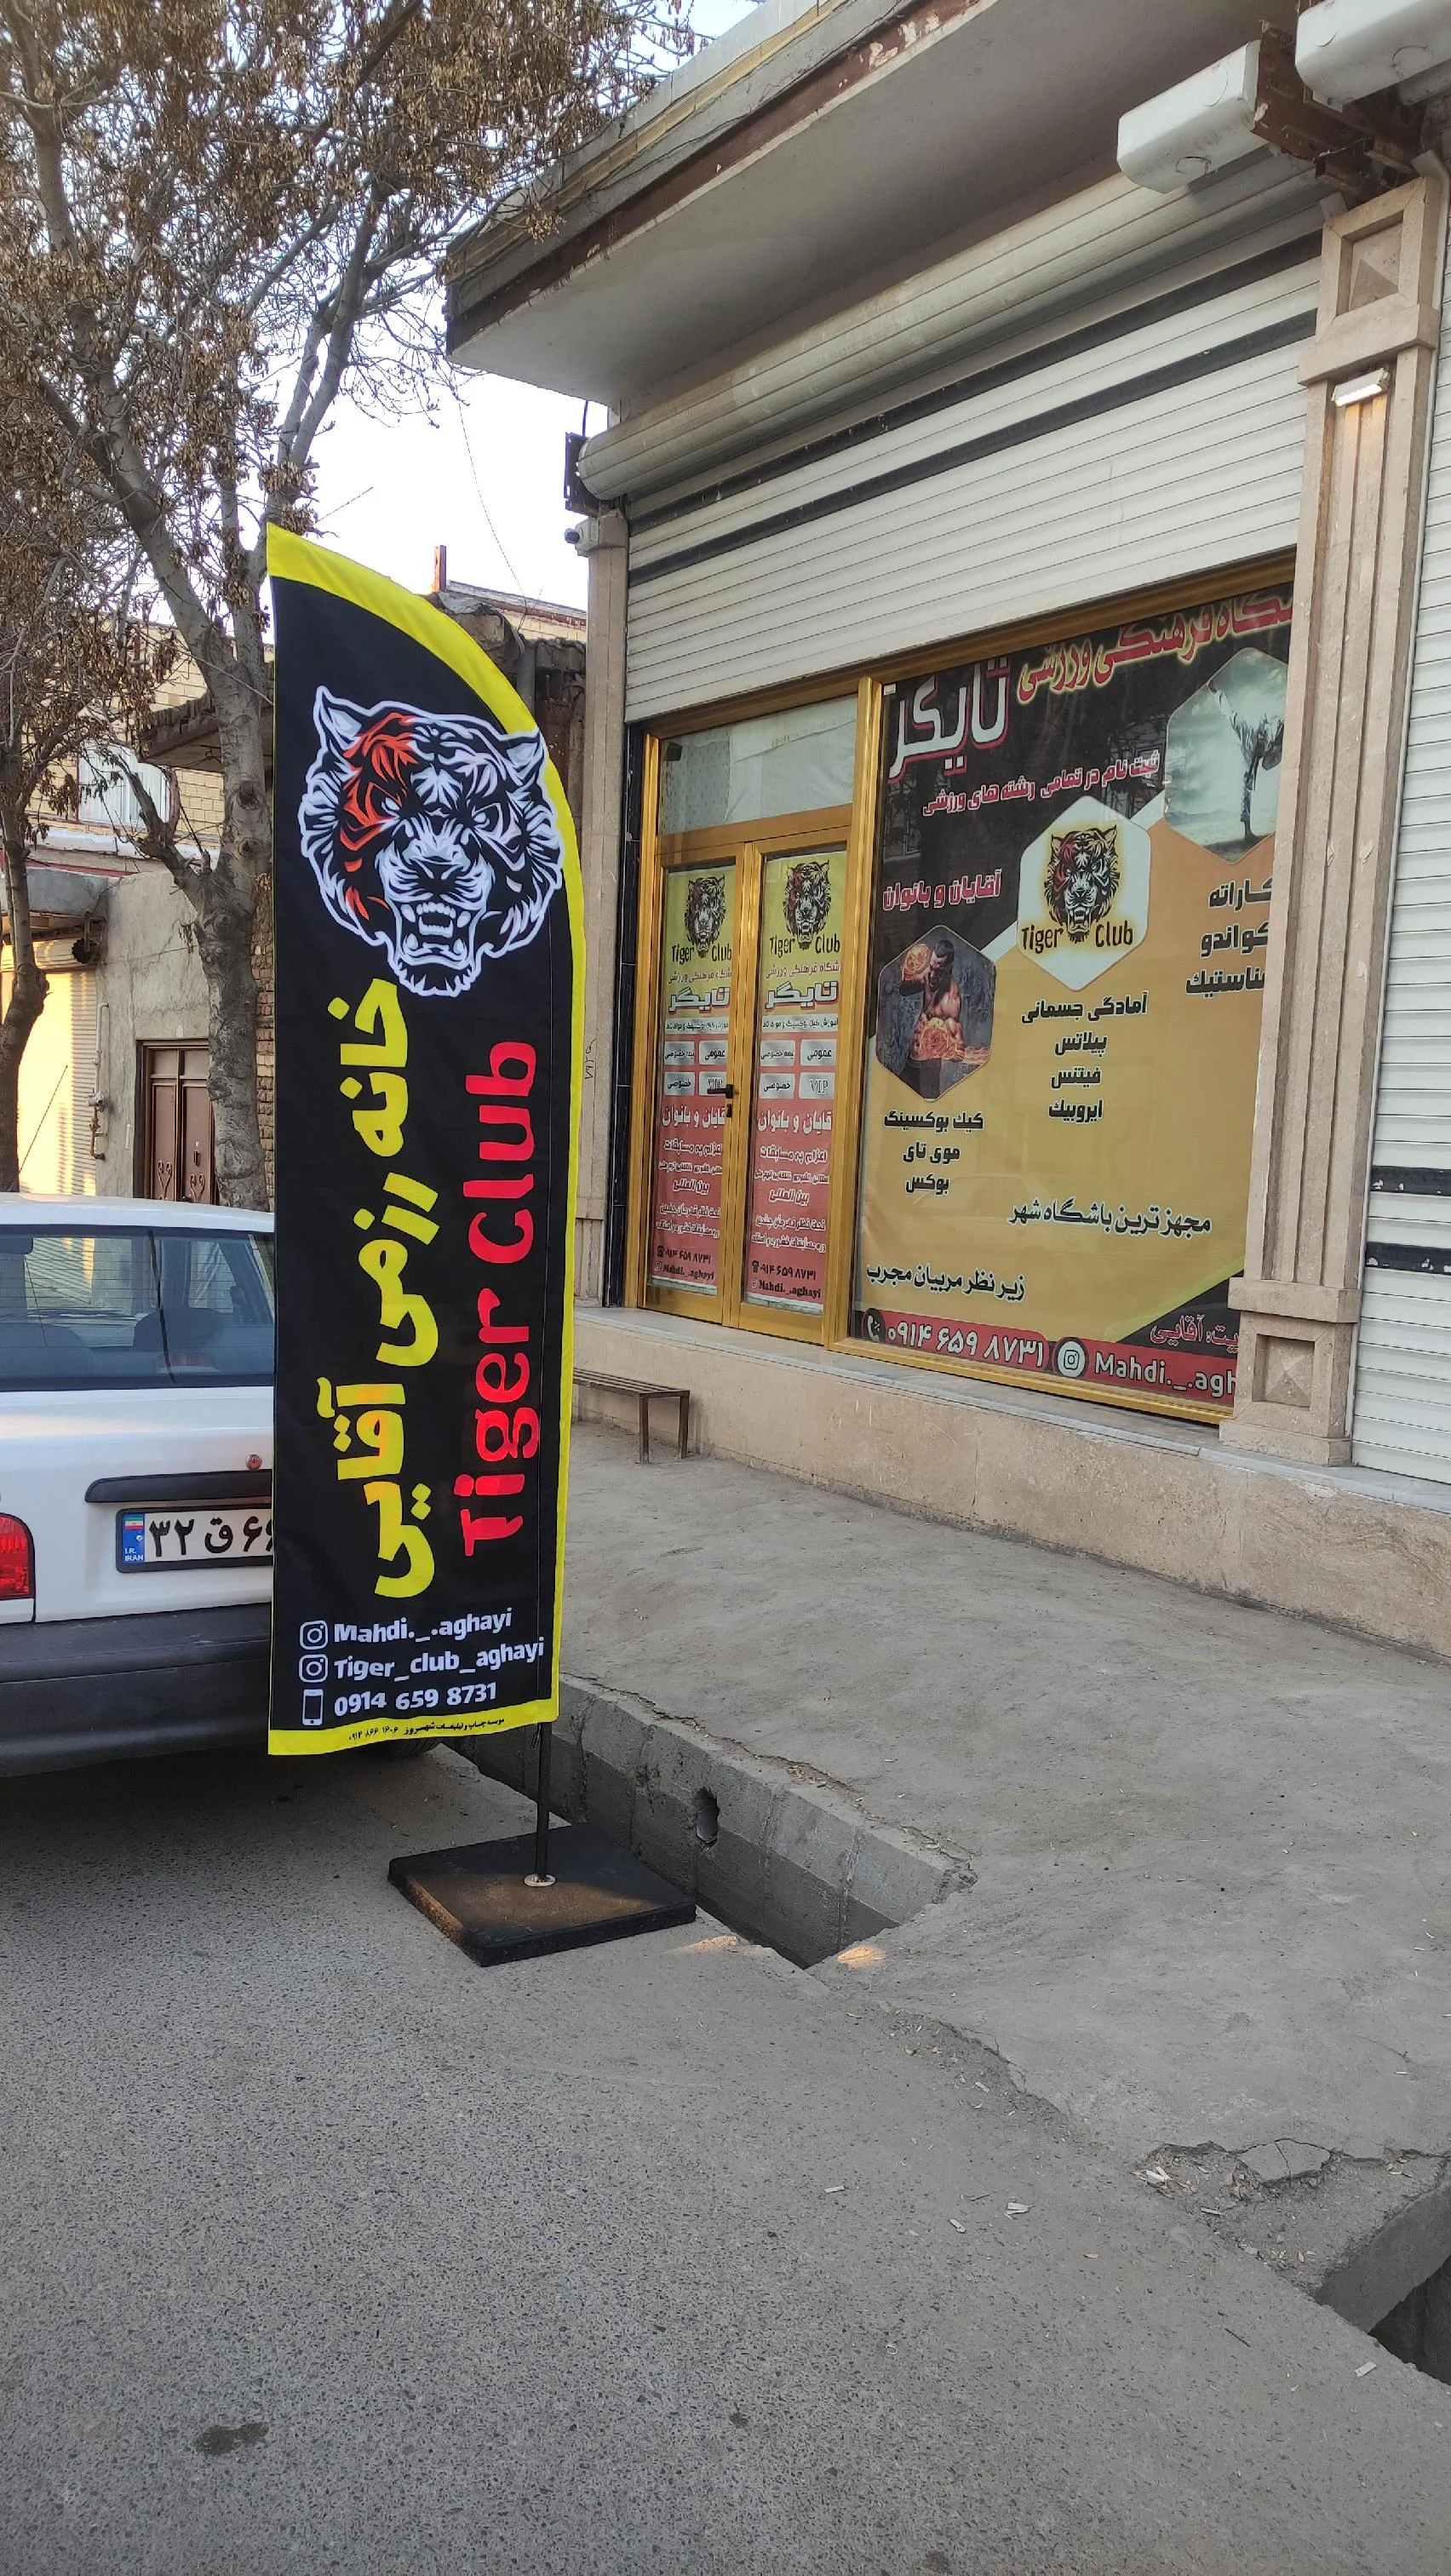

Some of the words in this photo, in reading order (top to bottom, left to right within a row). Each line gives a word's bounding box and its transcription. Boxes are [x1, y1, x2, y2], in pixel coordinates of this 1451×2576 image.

[1041, 768, 1083, 798] تمامی
[1085, 769, 1099, 790] در
[1102, 760, 1127, 787] نام
[967, 784, 1000, 810] های
[1001, 776, 1035, 800] رشته
[923, 789, 966, 816] ورزشی
[882, 881, 931, 912] بانوان
[934, 884, 946, 909] و
[949, 868, 1002, 905] آقایان
[770, 934, 795, 958] Tiger
[815, 933, 840, 954] Club
[1022, 925, 1064, 954] Tiger
[1095, 921, 1133, 948] Club
[672, 944, 694, 964] Tiger
[712, 944, 731, 961] Club
[668, 986, 731, 1014] تایگر
[765, 980, 838, 1012] تایگر
[1087, 990, 1149, 1022] آمادگی
[1021, 999, 1084, 1024] جسمانی
[807, 1049, 832, 1061] عمومی
[1054, 1031, 1108, 1058] پیلاتس
[327, 978, 409, 1158] خانه
[1051, 1066, 1101, 1089] فیتنس
[811, 1079, 829, 1093] VIP
[884, 1110, 949, 1133] بوکسینگ
[463, 1041, 536, 1263] Club
[903, 1141, 927, 1162] تای
[929, 1147, 961, 1164] موی
[905, 1173, 949, 1196] بوکس
[1007, 1198, 1041, 1225] شهر
[1043, 1196, 1113, 1233] باشگاه
[1114, 1203, 1161, 1236] ترین
[1159, 1207, 1212, 1239] مجهز
[353, 1172, 440, 1367] رزمی
[795, 1268, 816, 1280] ۸۷۳۱
[866, 1263, 911, 1286] مجرب
[914, 1262, 962, 1293] مربیان
[963, 1269, 995, 1294] نظر
[995, 1274, 1025, 1302] زیر
[1150, 1314, 1205, 1346] آقایی
[937, 1327, 978, 1356] ۶۵۹
[983, 1334, 1044, 1367] ۸۷۳۱
[454, 1288, 539, 1557] Tiger
[317, 1376, 435, 1598] آقایی
[149, 1518, 194, 1557] ۳۲
[204, 1517, 233, 1553] ق
[335, 1607, 512, 1644] Mahdi._.aghayi
[334, 1637, 544, 1682] Tiger_club_aghayi
[335, 1692, 387, 1717] 0914
[396, 1689, 439, 1710] 659
[446, 1682, 496, 1705] 8731
